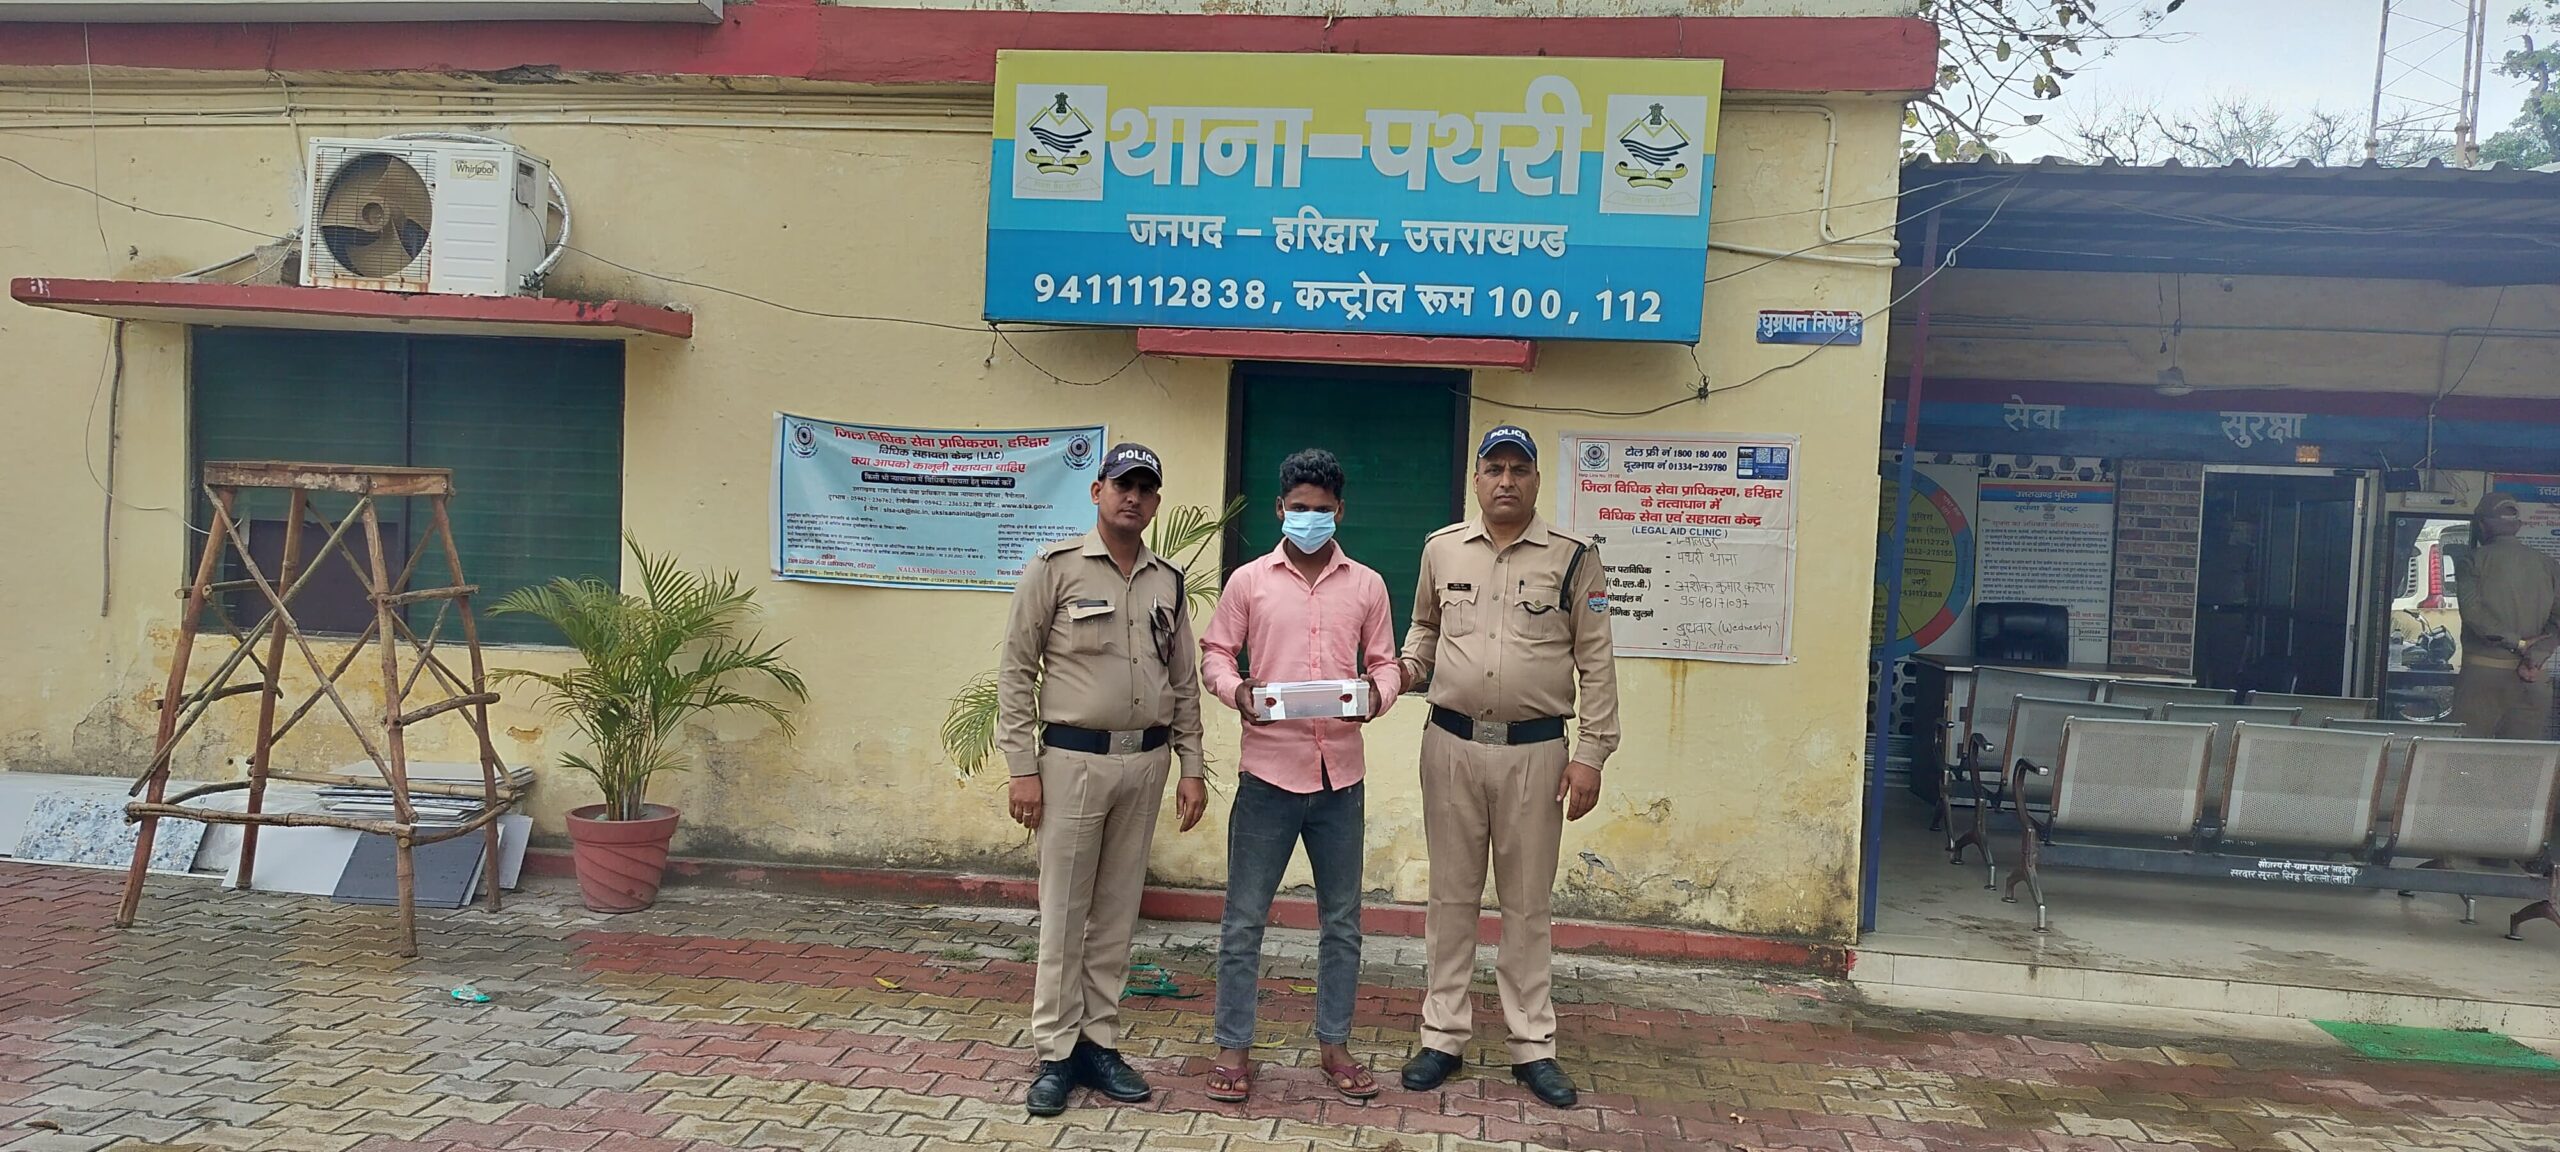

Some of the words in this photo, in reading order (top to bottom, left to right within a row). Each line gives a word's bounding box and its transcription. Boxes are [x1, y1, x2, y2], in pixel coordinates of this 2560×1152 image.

[1108, 75, 1592, 197] थाना-पथरी
[456, 163, 495, 175] Whirlpool
[1127, 213, 1226, 249] जनपद
[1273, 206, 1389, 257] हरिद्वार,
[1402, 220, 1567, 258] उत्तराखण्ड
[1034, 274, 1281, 314] 9411112838,
[1294, 272, 1403, 321] कन्ट्रोल
[1416, 284, 1473, 316] रूम
[1489, 287, 1578, 325] 100,
[1596, 290, 1662, 322] 112
[1848, 312, 1862, 336] है
[2003, 394, 2065, 431] सेवा
[2220, 411, 2307, 448] सुरक्षा
[834, 426, 866, 440] जिला
[867, 431, 906, 446] विधिक
[911, 435, 935, 448] सेवा
[1008, 435, 1051, 448] हरिद्वार
[879, 444, 909, 457] विधिक
[912, 449, 949, 460] सहायता
[976, 450, 1005, 462] (LAC)
[1117, 449, 1159, 470] POLICE
[1624, 446, 1644, 457] टोल
[1645, 445, 1659, 458] फ्री
[1661, 446, 1673, 457] नं
[1673, 450, 1693, 458] 1800
[1695, 450, 1710, 458] 180
[851, 455, 870, 467] क्या
[873, 458, 910, 470] आपको
[912, 461, 950, 474] कानूनी
[952, 463, 992, 472] सहायता
[1657, 459, 1668, 470] नं
[1668, 463, 1728, 472] 01334-239780
[881, 473, 890, 482] भी
[1581, 480, 1612, 493] जिला
[1615, 481, 1652, 494] विधिक
[1656, 482, 1678, 495] सेवा
[1681, 482, 1740, 497] प्राधिकरण,
[1744, 484, 1784, 499] हरिद्वार
[2015, 490, 2053, 500] उत्तराखण्ड
[2054, 489, 2078, 501] पुलिस
[1001, 503, 1054, 511] www.slsa.gov.in
[1640, 495, 1654, 508] के
[1657, 499, 1707, 510] तत्वाधान
[1709, 498, 1723, 510] में
[1599, 507, 1637, 521] विधिक
[1639, 509, 1663, 523] सेवा
[1665, 510, 1685, 523] एवं
[1685, 513, 1732, 525] सहायता
[1734, 512, 1763, 526] केन्द्र
[1631, 525, 1667, 536] (LEGAL
[1669, 527, 1687, 536] AID
